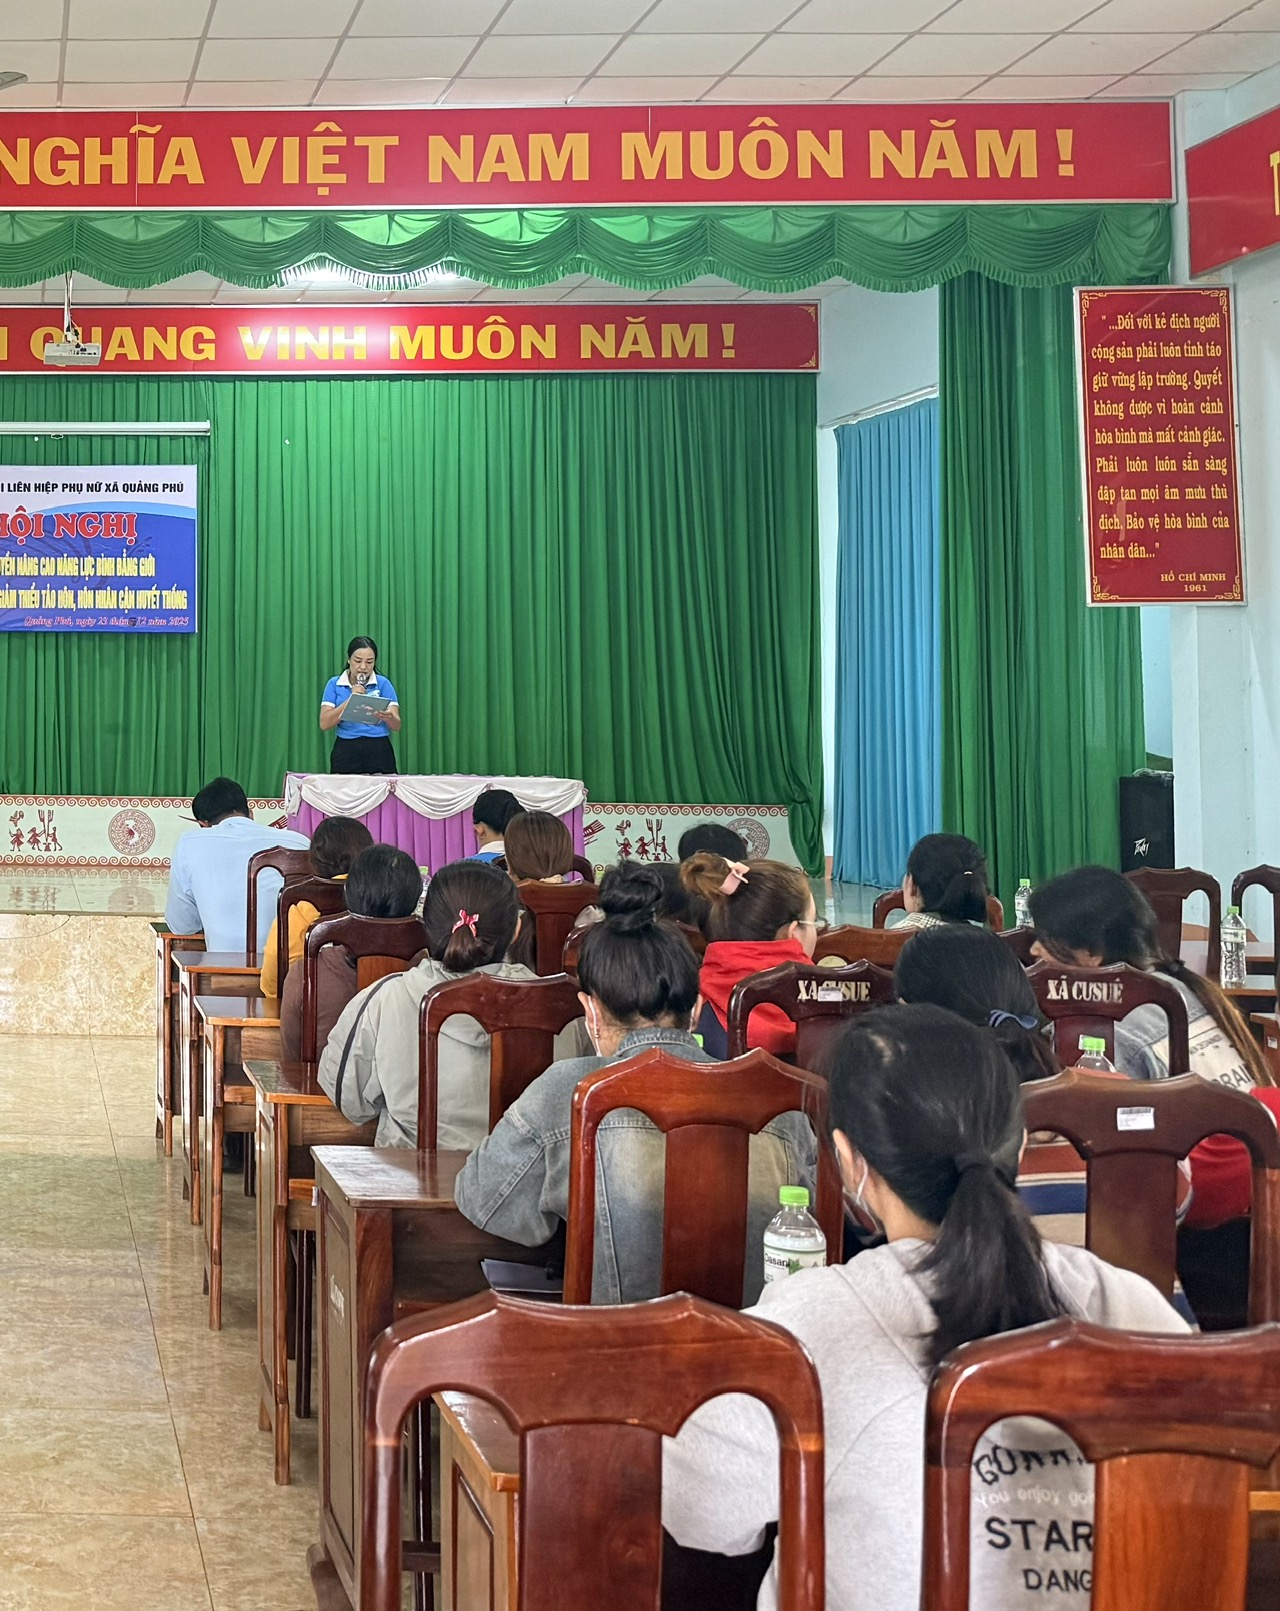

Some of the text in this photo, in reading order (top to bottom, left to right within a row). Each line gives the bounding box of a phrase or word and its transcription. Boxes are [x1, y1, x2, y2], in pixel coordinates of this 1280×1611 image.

[233, 123, 399, 195] VIỆT
[430, 134, 589, 182] NAM
[622, 118, 843, 180] MUÔN
[871, 121, 1037, 178] NĂM
[1057, 130, 1073, 175] !
[1136, 313, 1153, 330] với
[1154, 312, 1167, 329] kẻ
[1193, 312, 1221, 333] người
[239, 328, 367, 360] VINH
[391, 316, 556, 360] MUÔN
[581, 318, 708, 358] NĂM
[723, 324, 735, 358] !
[1091, 343, 1115, 364] cộng
[1116, 340, 1134, 358] sản
[1136, 340, 1158, 362] phải
[1160, 342, 1182, 358] luôn
[1206, 341, 1222, 357] táo
[1138, 370, 1153, 391] lập
[1193, 366, 1223, 390] Quyết
[1094, 399, 1125, 420] không
[1156, 398, 1166, 415] vì
[1171, 398, 1195, 414] hoàn
[1200, 395, 1223, 414] cảnh
[1094, 424, 1225, 448] hòa bình mà mất cảnh giác.
[1096, 454, 1119, 473] Phải
[1125, 456, 1148, 472] luôn
[1155, 455, 1177, 472] luôn
[1205, 455, 1228, 476] sàng
[8, 481, 31, 493] LIÊN
[34, 481, 58, 495] HIỆP
[61, 483, 83, 495] PHỤ
[86, 481, 103, 493] NỮ
[104, 481, 119, 493] XÃ
[122, 480, 159, 493] QUẢNG
[162, 481, 184, 493] PHÚ
[1120, 486, 1137, 501] tan
[1140, 483, 1160, 504] mọi
[1164, 484, 1180, 500] âm
[1211, 483, 1228, 499] thù
[53, 513, 138, 545] NGHỊ
[1125, 510, 1230, 533] Bảo vệ hòa bình của
[1100, 542, 1125, 559] nhân
[1178, 571, 1197, 582] CHÍ
[1199, 573, 1226, 582] MINH
[1184, 584, 1207, 592] 1961
